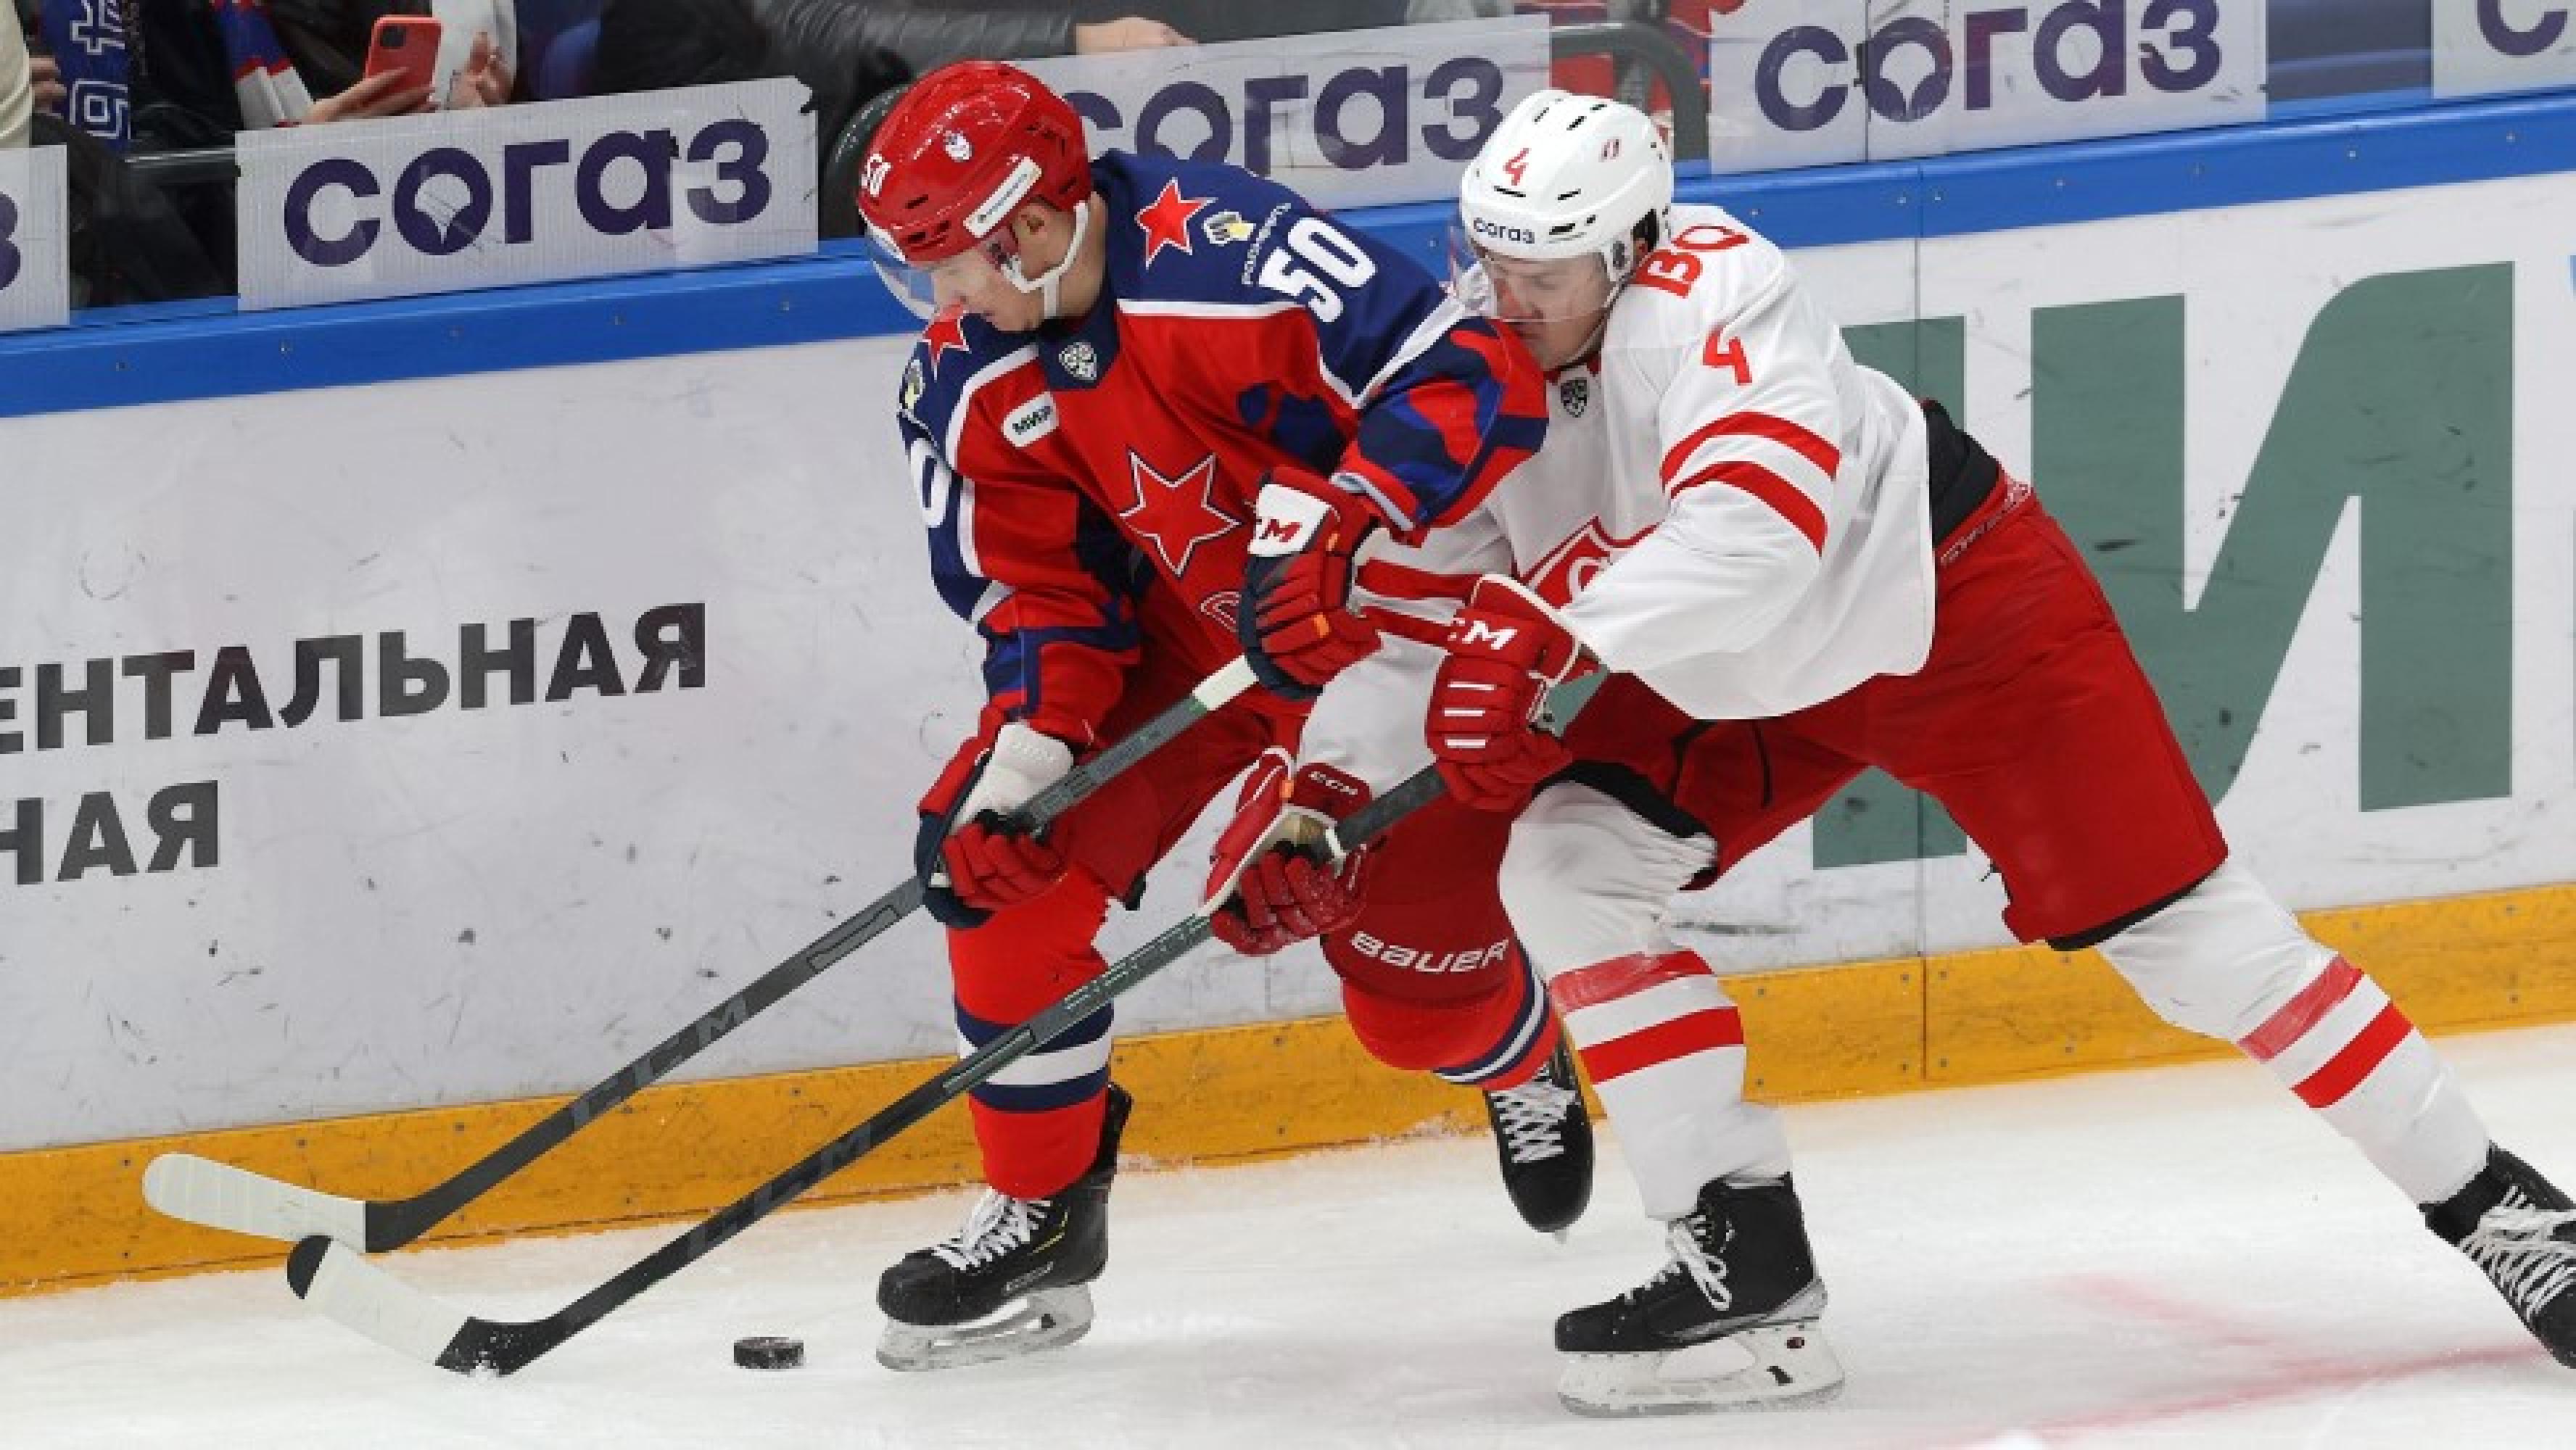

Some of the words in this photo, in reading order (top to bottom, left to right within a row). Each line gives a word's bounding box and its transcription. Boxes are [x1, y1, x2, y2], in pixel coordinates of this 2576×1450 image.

[1503, 148, 1529, 186] 4
[1258, 218, 1378, 323] 50
[1702, 323, 1752, 385] 4
